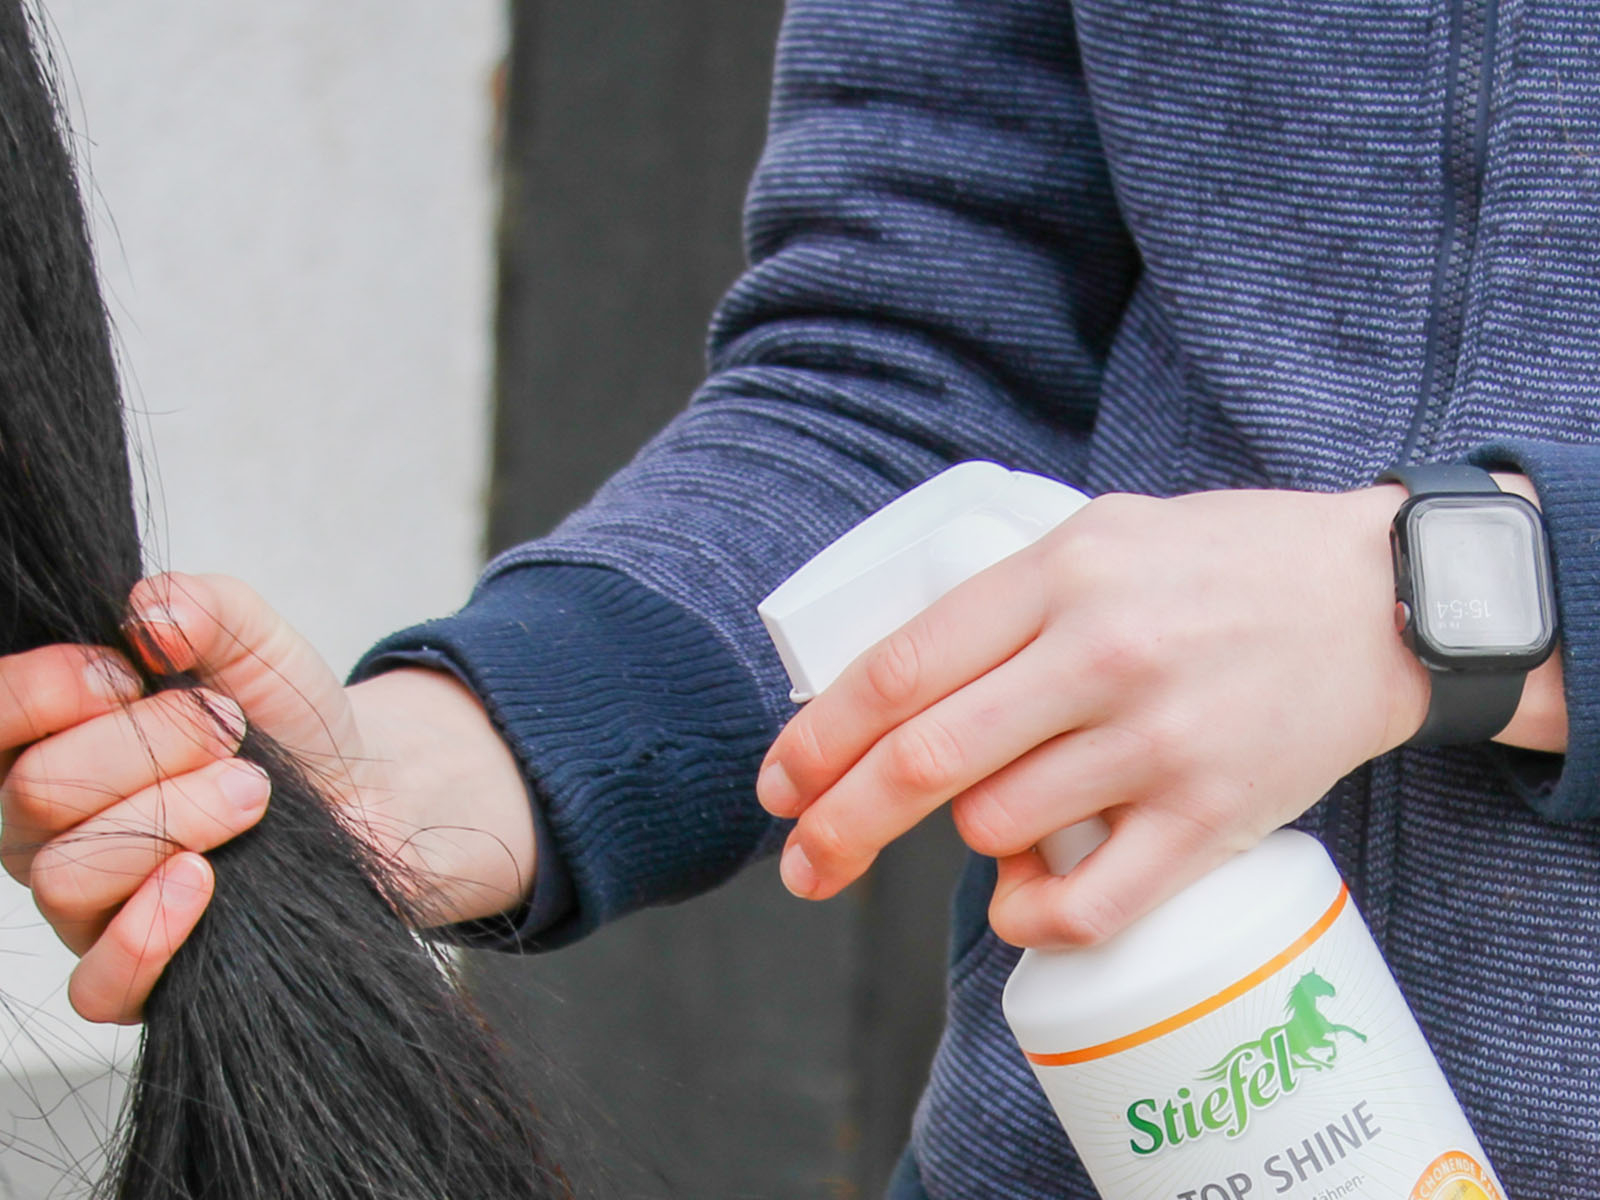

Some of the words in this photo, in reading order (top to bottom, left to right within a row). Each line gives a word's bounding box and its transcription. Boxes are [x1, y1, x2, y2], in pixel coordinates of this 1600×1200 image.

[1437, 599, 1491, 619] 15:54
[1126, 1030, 1298, 1154] Stiefel
[1263, 1099, 1382, 1194] SHINE
